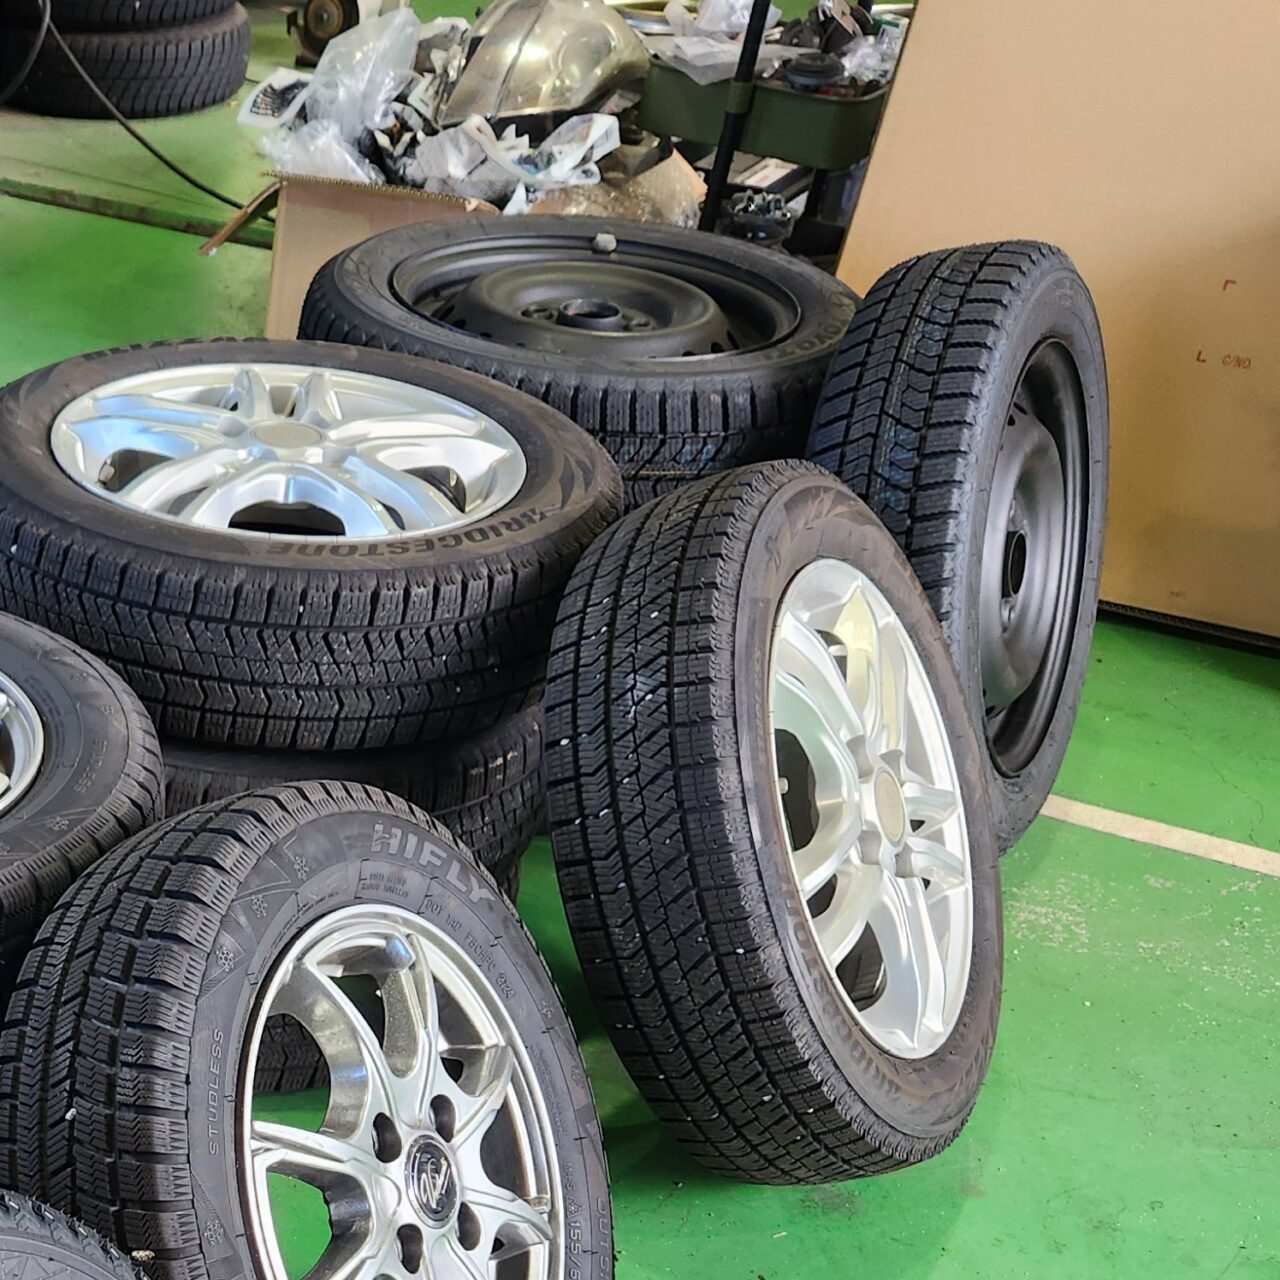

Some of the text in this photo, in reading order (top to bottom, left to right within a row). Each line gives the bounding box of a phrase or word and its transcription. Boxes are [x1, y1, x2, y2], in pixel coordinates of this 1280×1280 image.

[268, 507, 548, 558] BRIDGESTONE
[370, 822, 496, 904] HIFLY
[209, 1028, 224, 1155] STUDLESS
